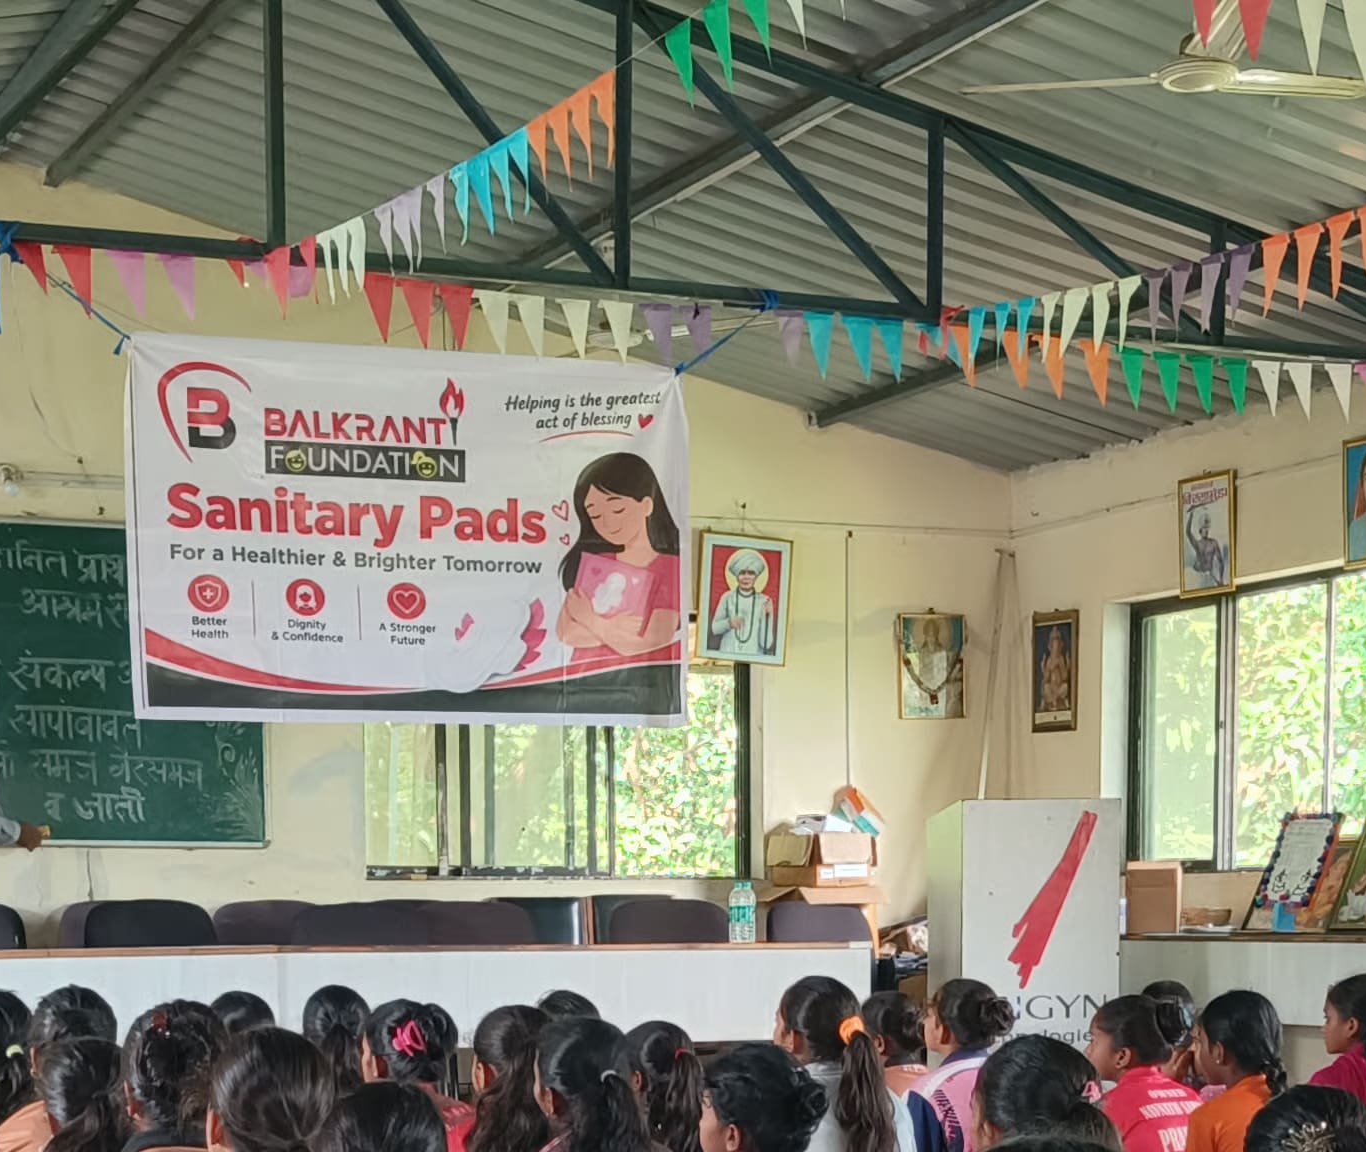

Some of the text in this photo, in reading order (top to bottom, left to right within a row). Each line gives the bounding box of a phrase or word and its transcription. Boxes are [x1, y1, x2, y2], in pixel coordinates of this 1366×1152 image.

[505, 391, 661, 413] Helping is the greatest
[536, 411, 632, 430] act of blessing
[167, 482, 547, 548] Sanitary Pads
[170, 543, 543, 574] For a Healthier & Brighter Tomorrow
[192, 616, 229, 640] Better Health
[288, 620, 326, 632] Dignity
[380, 623, 436, 635] A Stronger
[271, 631, 343, 643] & Confidence
[391, 635, 425, 646] Future
